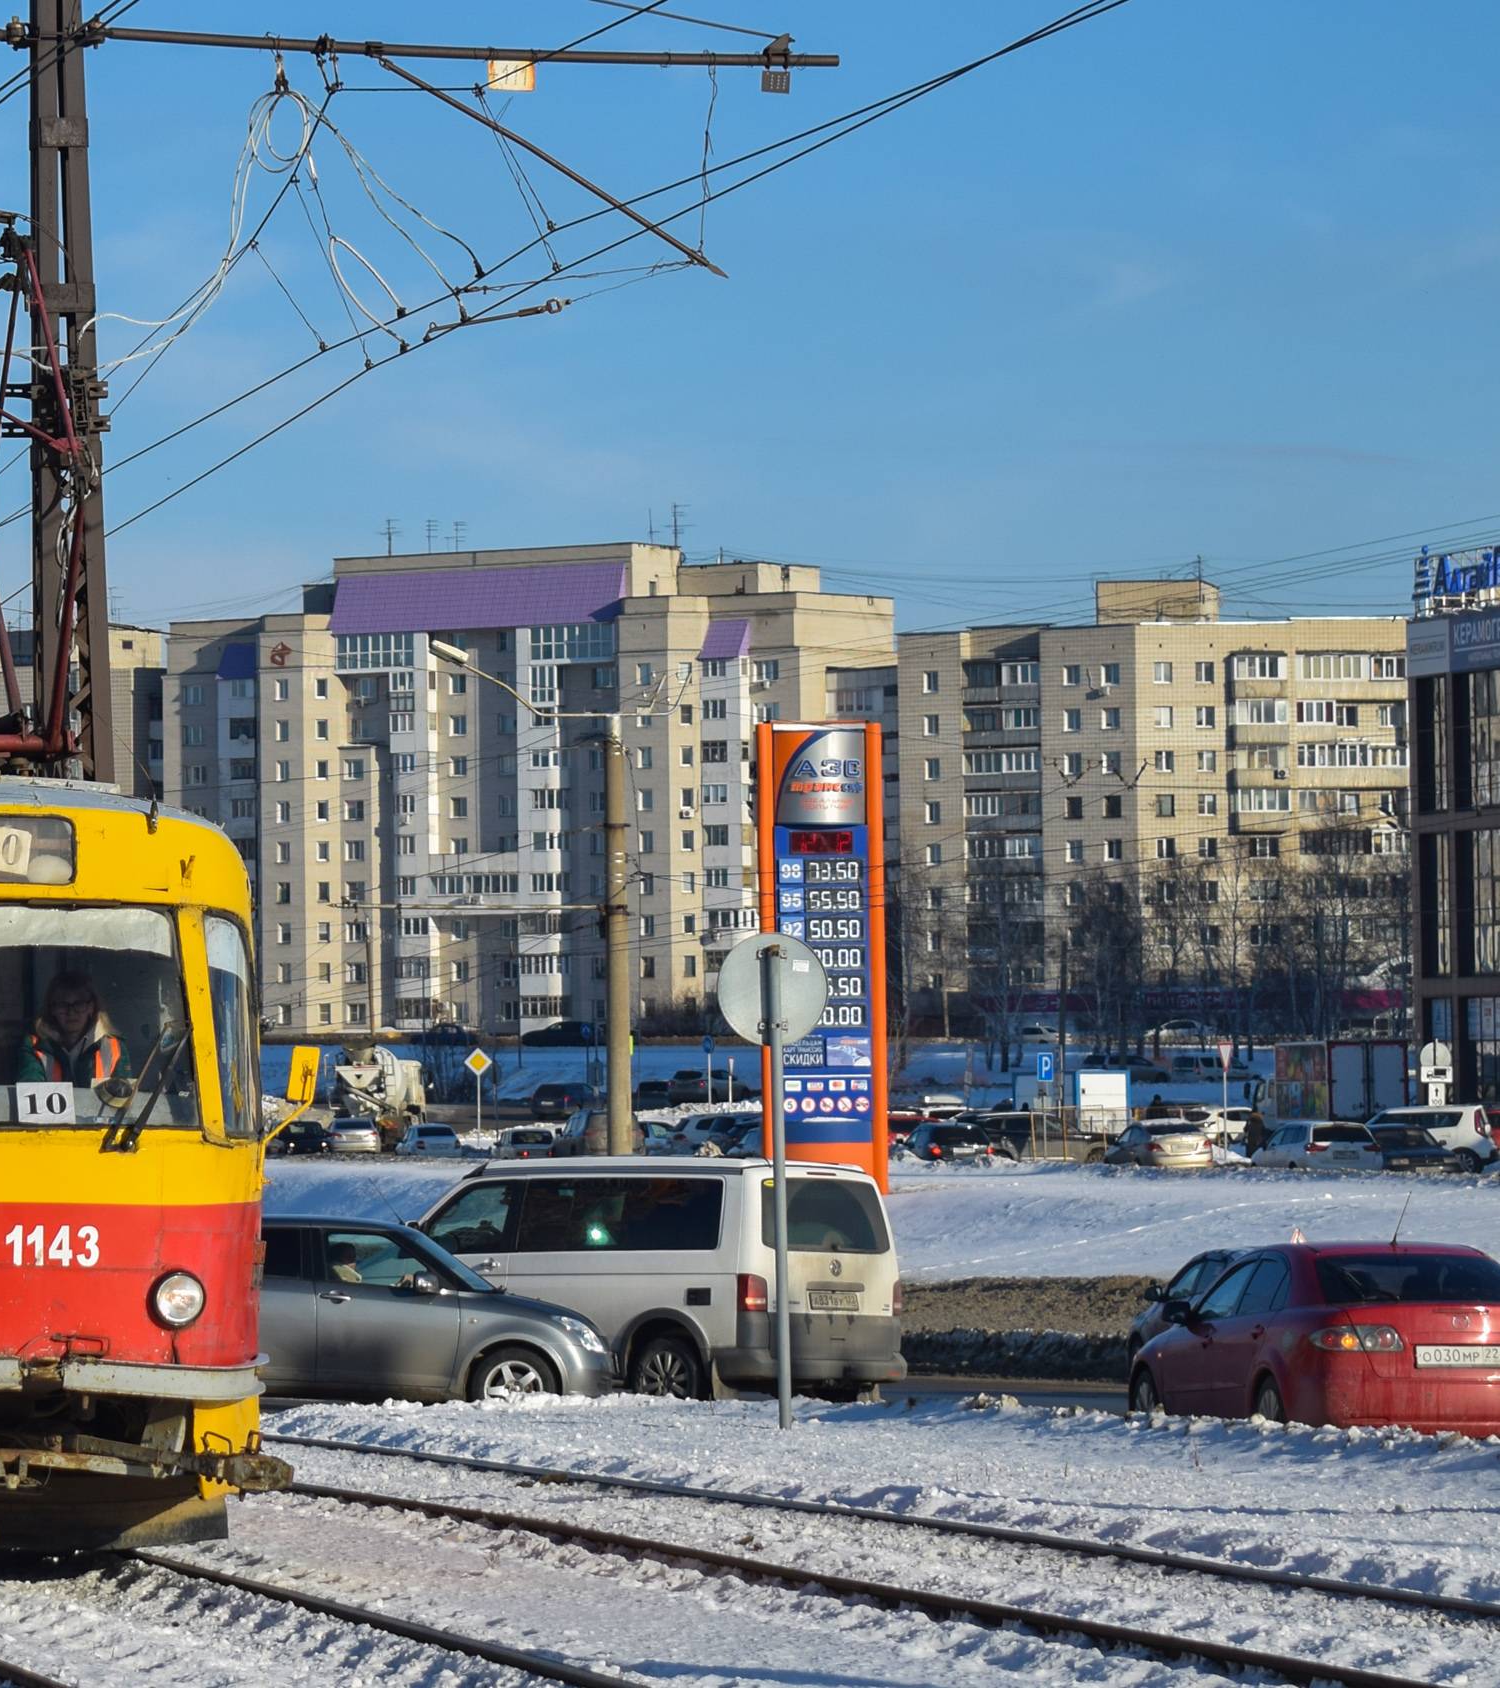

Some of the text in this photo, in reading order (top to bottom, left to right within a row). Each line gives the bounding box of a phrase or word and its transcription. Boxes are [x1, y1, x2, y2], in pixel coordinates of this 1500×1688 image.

[1432, 545, 1500, 596] Алтай
[793, 759, 861, 778] АЗС
[781, 861, 859, 881] 98 73.50
[782, 893, 802, 908] 95
[782, 919, 860, 938] 92 50.50
[817, 1006, 862, 1025] 0.00
[783, 1053, 823, 1066] СКИДКИ
[23, 1091, 67, 1115] 10
[4, 1224, 100, 1268] 1143
[1422, 1348, 1499, 1362] О030МР 22
